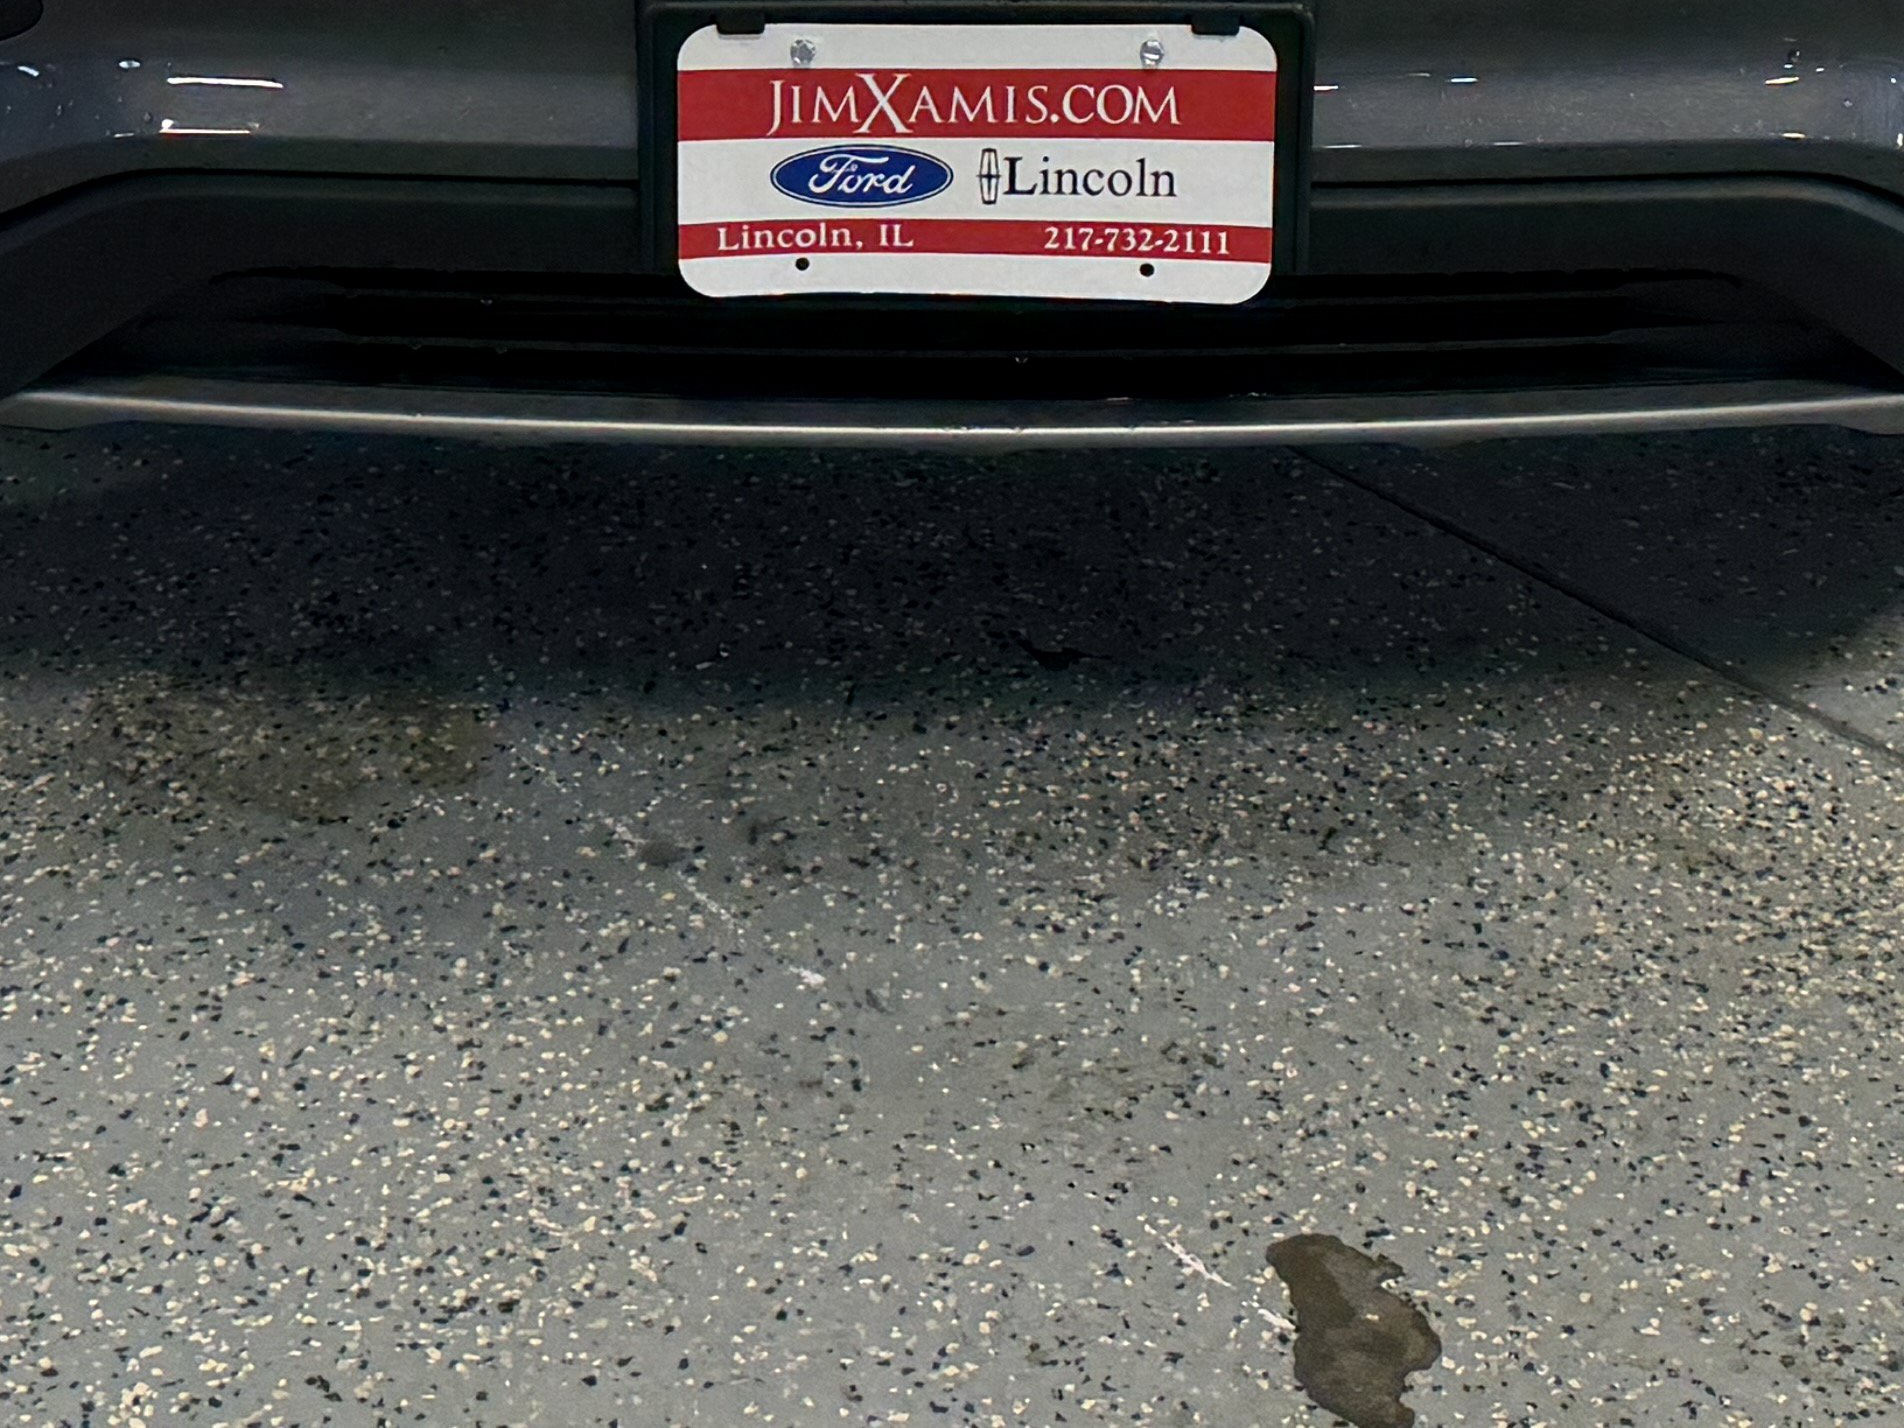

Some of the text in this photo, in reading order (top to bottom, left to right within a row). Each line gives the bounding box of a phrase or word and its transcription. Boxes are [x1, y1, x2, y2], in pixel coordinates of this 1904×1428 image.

[766, 73, 1183, 137] JIMXAMIS.COM
[806, 156, 913, 196] Ford
[1002, 156, 1178, 199] Lincoln
[717, 223, 915, 251] Lincoln, IL
[1043, 225, 1230, 256] 217-732-2111
